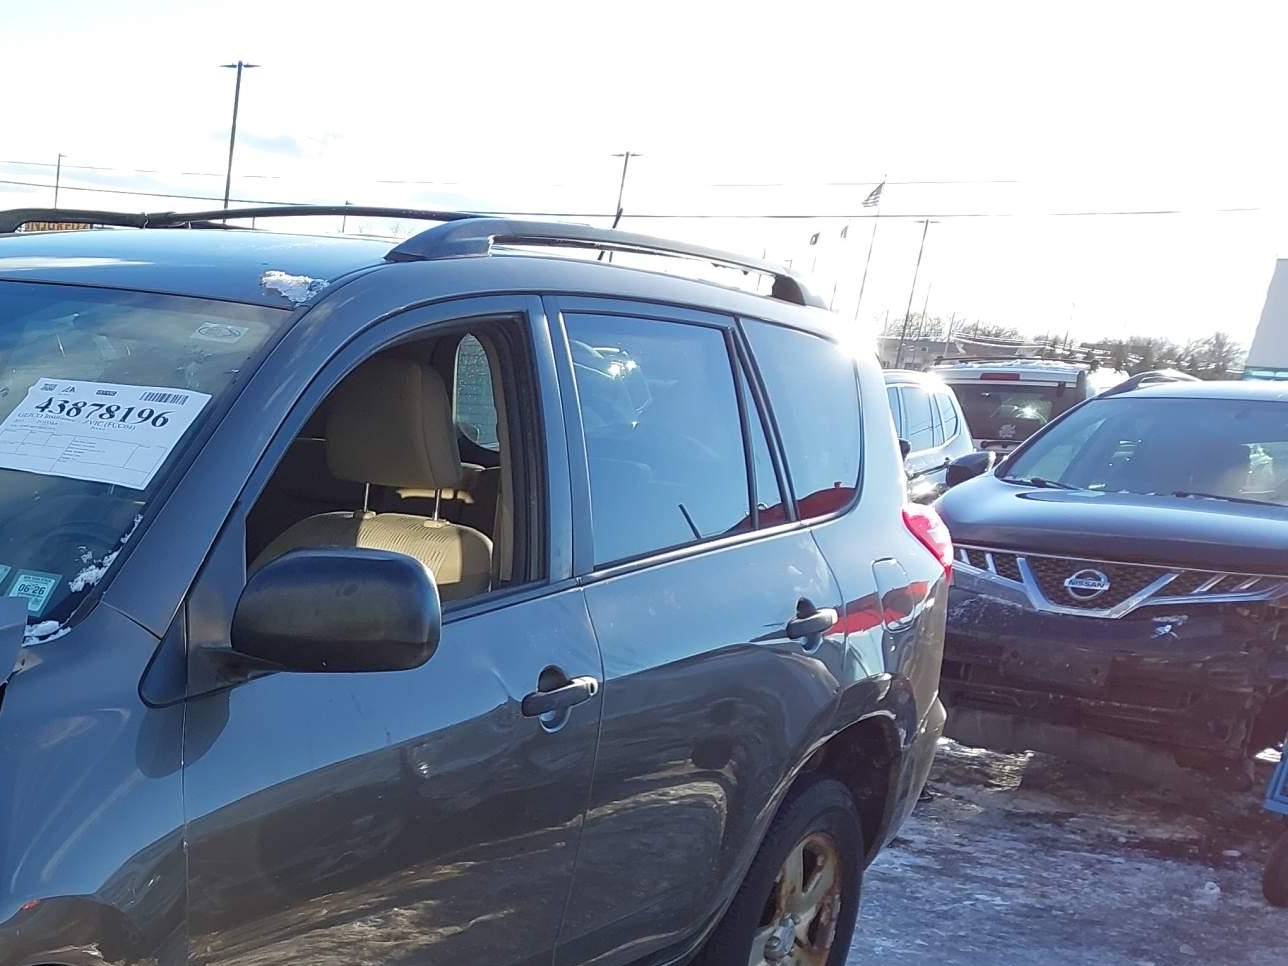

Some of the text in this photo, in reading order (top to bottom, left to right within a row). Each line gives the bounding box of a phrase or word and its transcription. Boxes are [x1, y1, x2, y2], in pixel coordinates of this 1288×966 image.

[34, 397, 176, 428] 43878196
[18, 583, 31, 593] 06
[32, 585, 46, 595] 26
